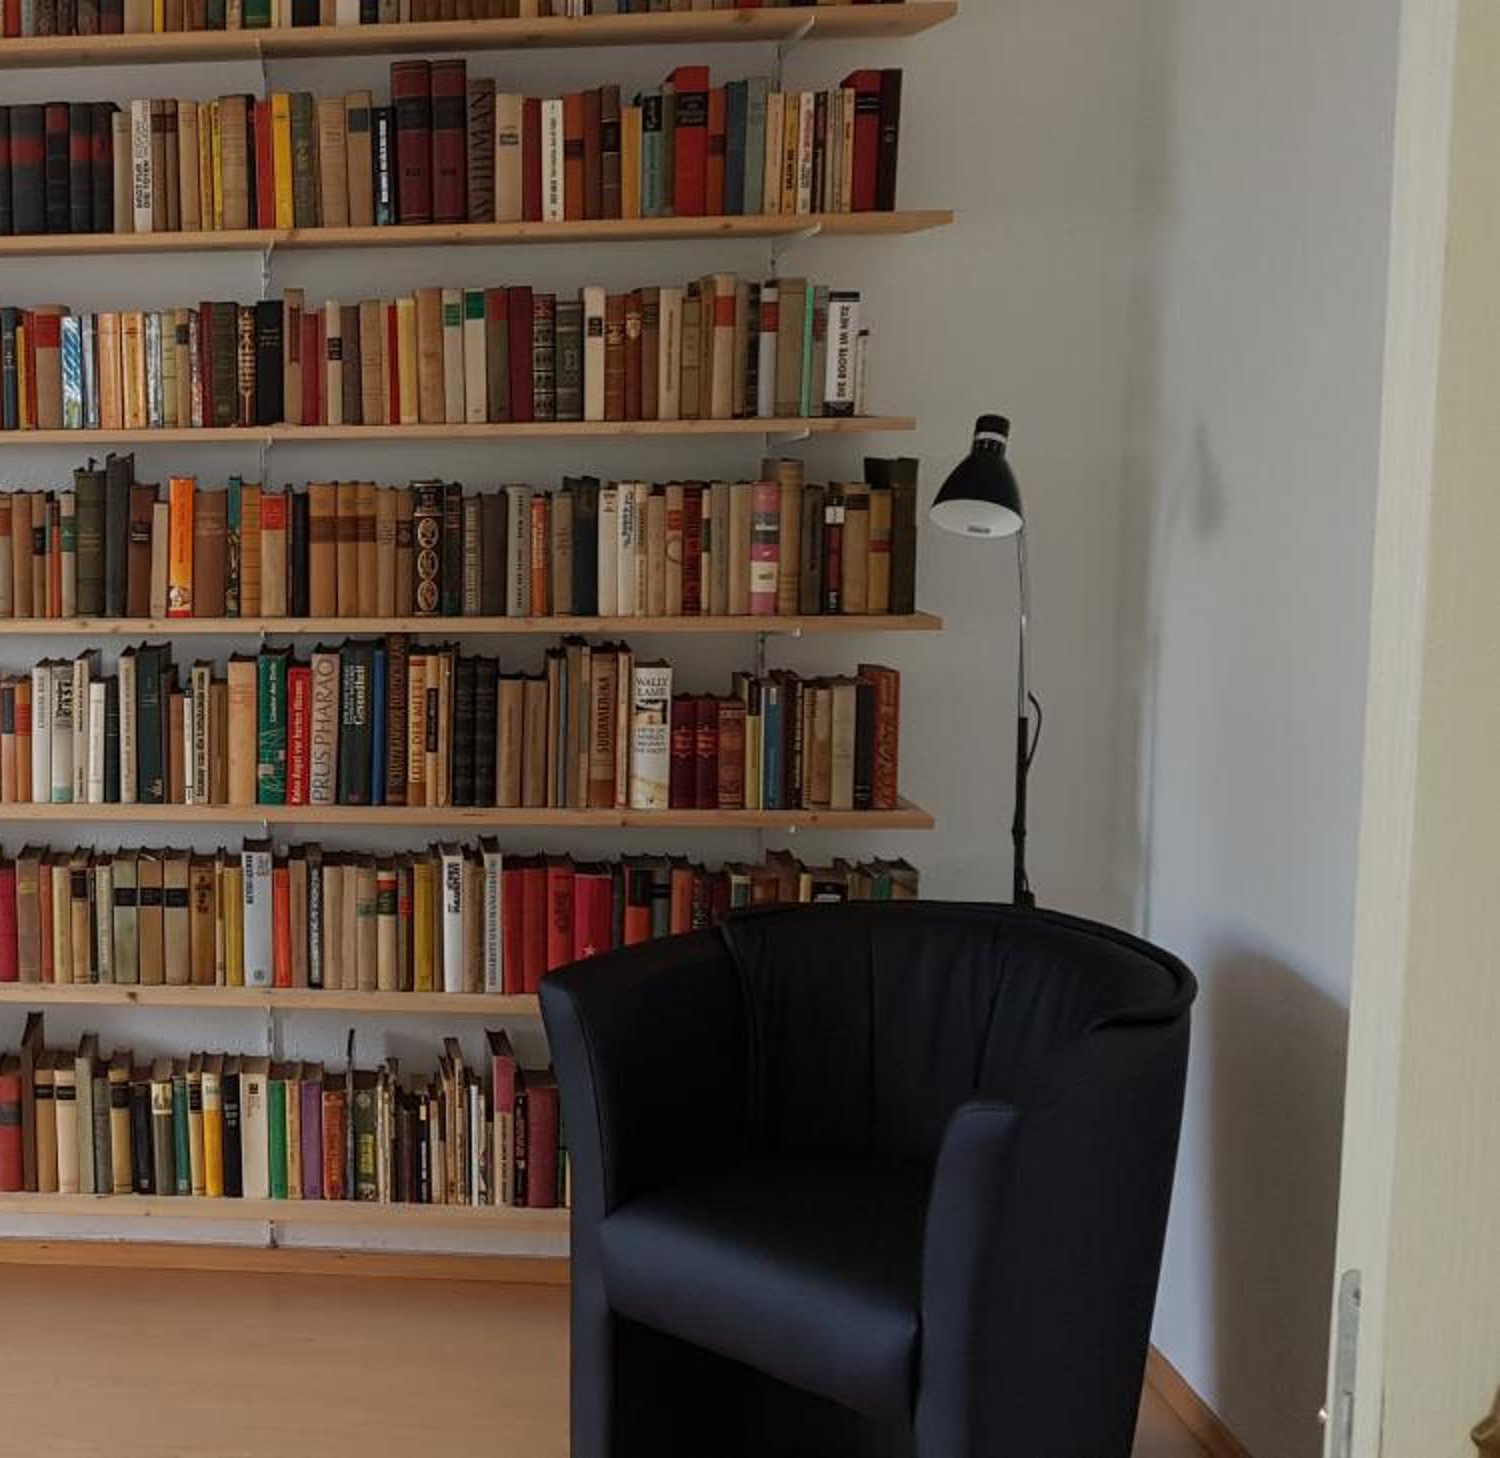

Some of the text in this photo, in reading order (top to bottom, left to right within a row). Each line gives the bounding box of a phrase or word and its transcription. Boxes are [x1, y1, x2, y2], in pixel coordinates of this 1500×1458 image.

[838, 331, 849, 345] IM
[837, 348, 848, 379] BOOTE
[836, 381, 846, 398] DIE
[636, 677, 668, 686] WALLY
[355, 665, 365, 725] Gesundheit
[637, 688, 667, 696] LAMB
[312, 658, 335, 801] PRUS PHARAO
